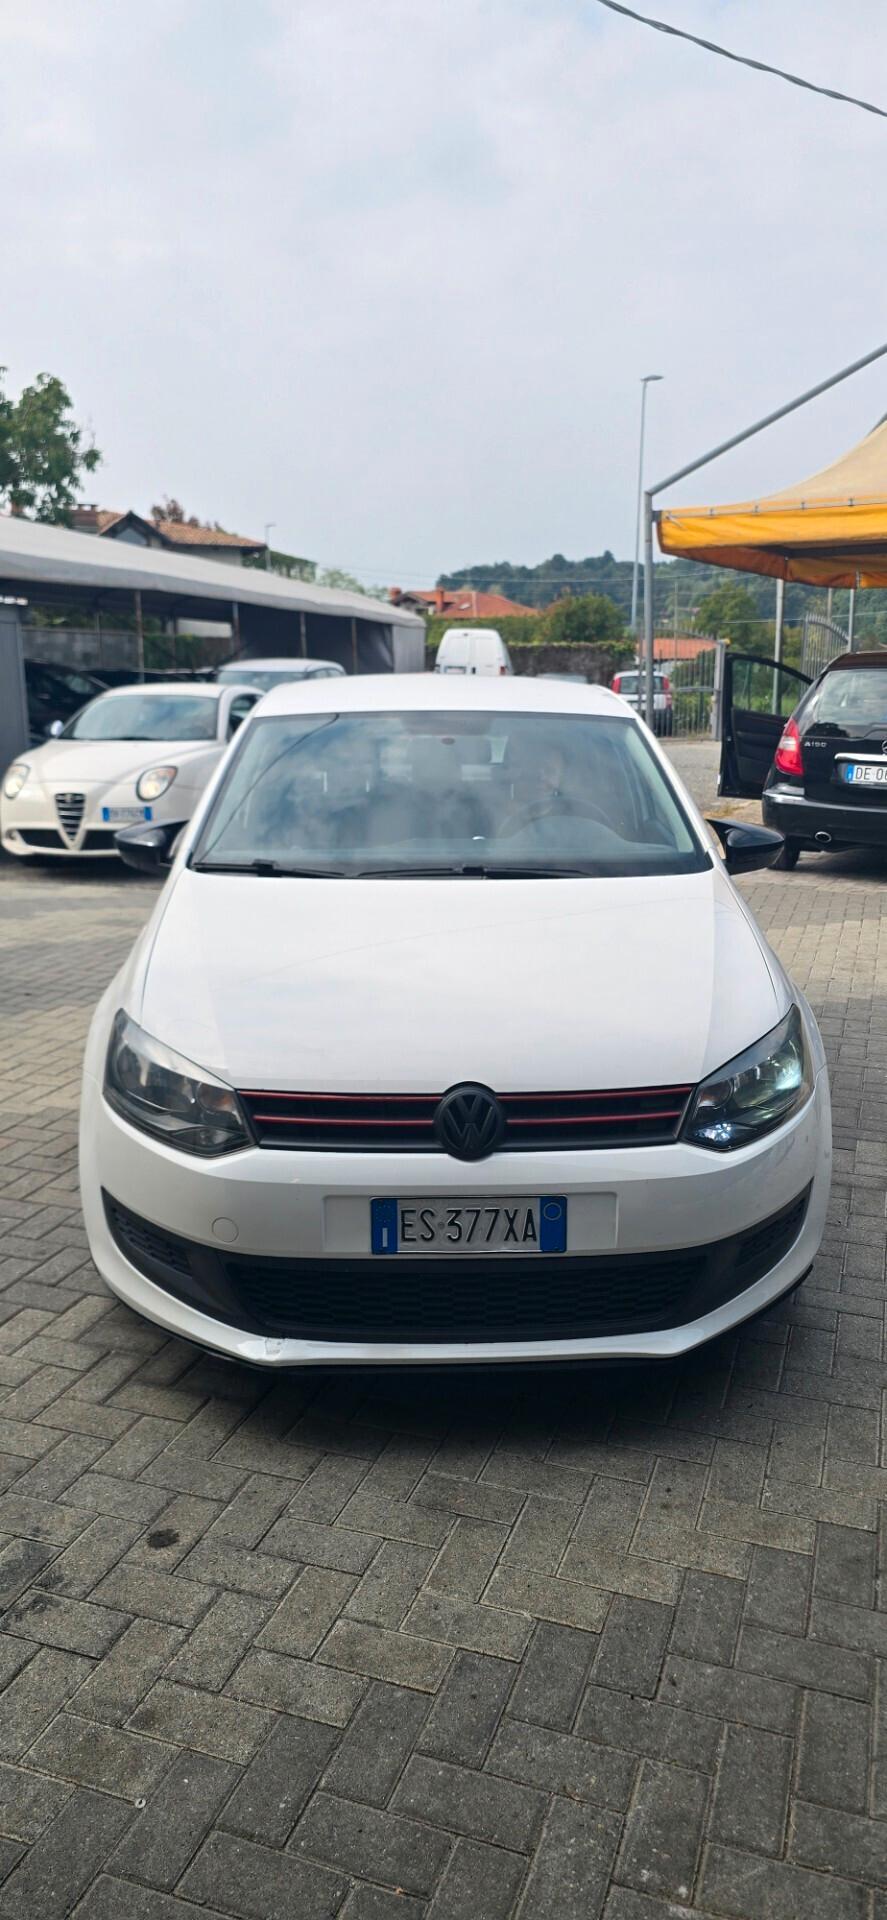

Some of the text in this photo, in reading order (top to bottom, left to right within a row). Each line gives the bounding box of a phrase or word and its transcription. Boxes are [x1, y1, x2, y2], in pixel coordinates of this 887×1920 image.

[856, 767, 872, 781] DE
[442, 1090, 498, 1154] VW
[401, 1208, 436, 1242] ES
[447, 1208, 538, 1242] 377XA
